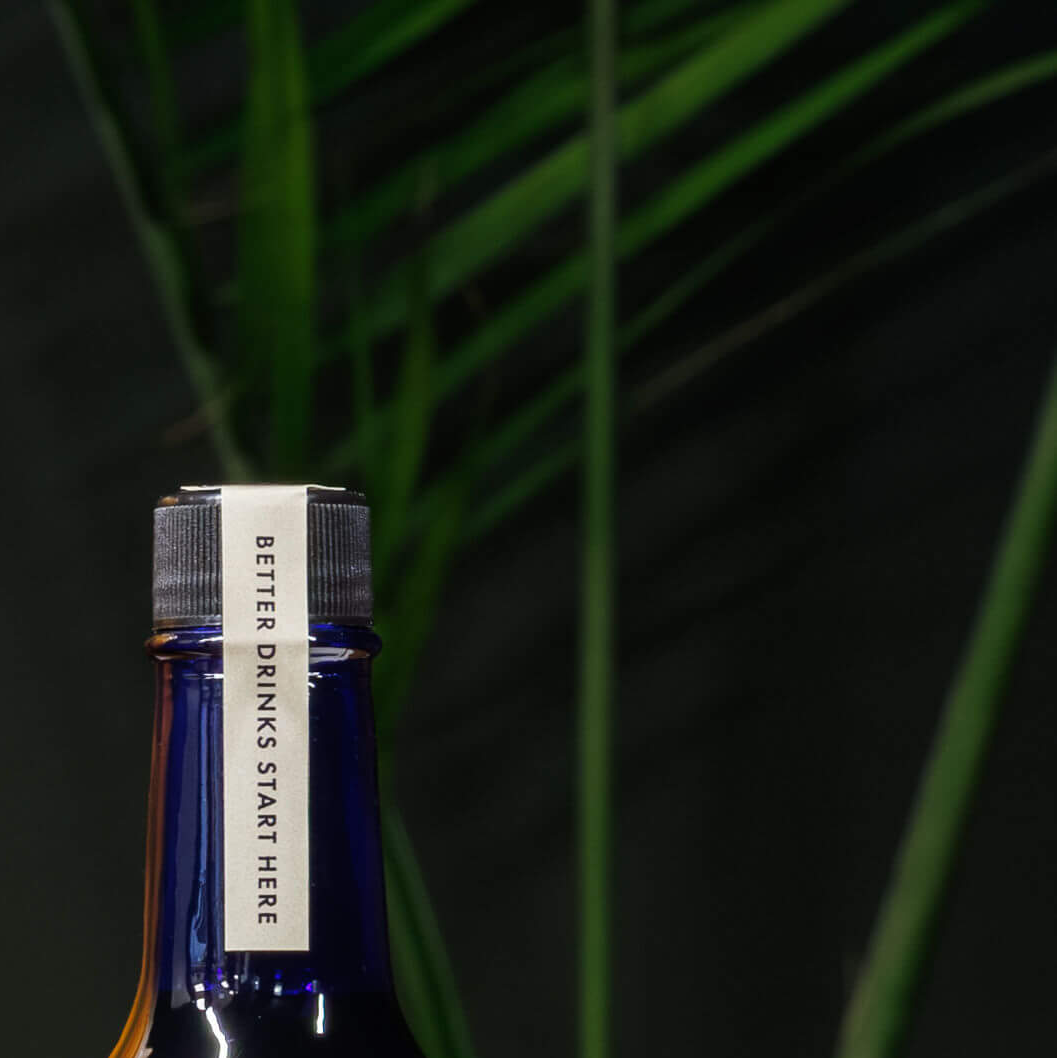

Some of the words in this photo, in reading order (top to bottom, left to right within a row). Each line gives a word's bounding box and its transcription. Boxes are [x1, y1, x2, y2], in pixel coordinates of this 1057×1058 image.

[255, 535, 276, 631] BETTER
[256, 643, 278, 749] DRINKS
[256, 761, 278, 844] START
[257, 855, 278, 925] HERE
